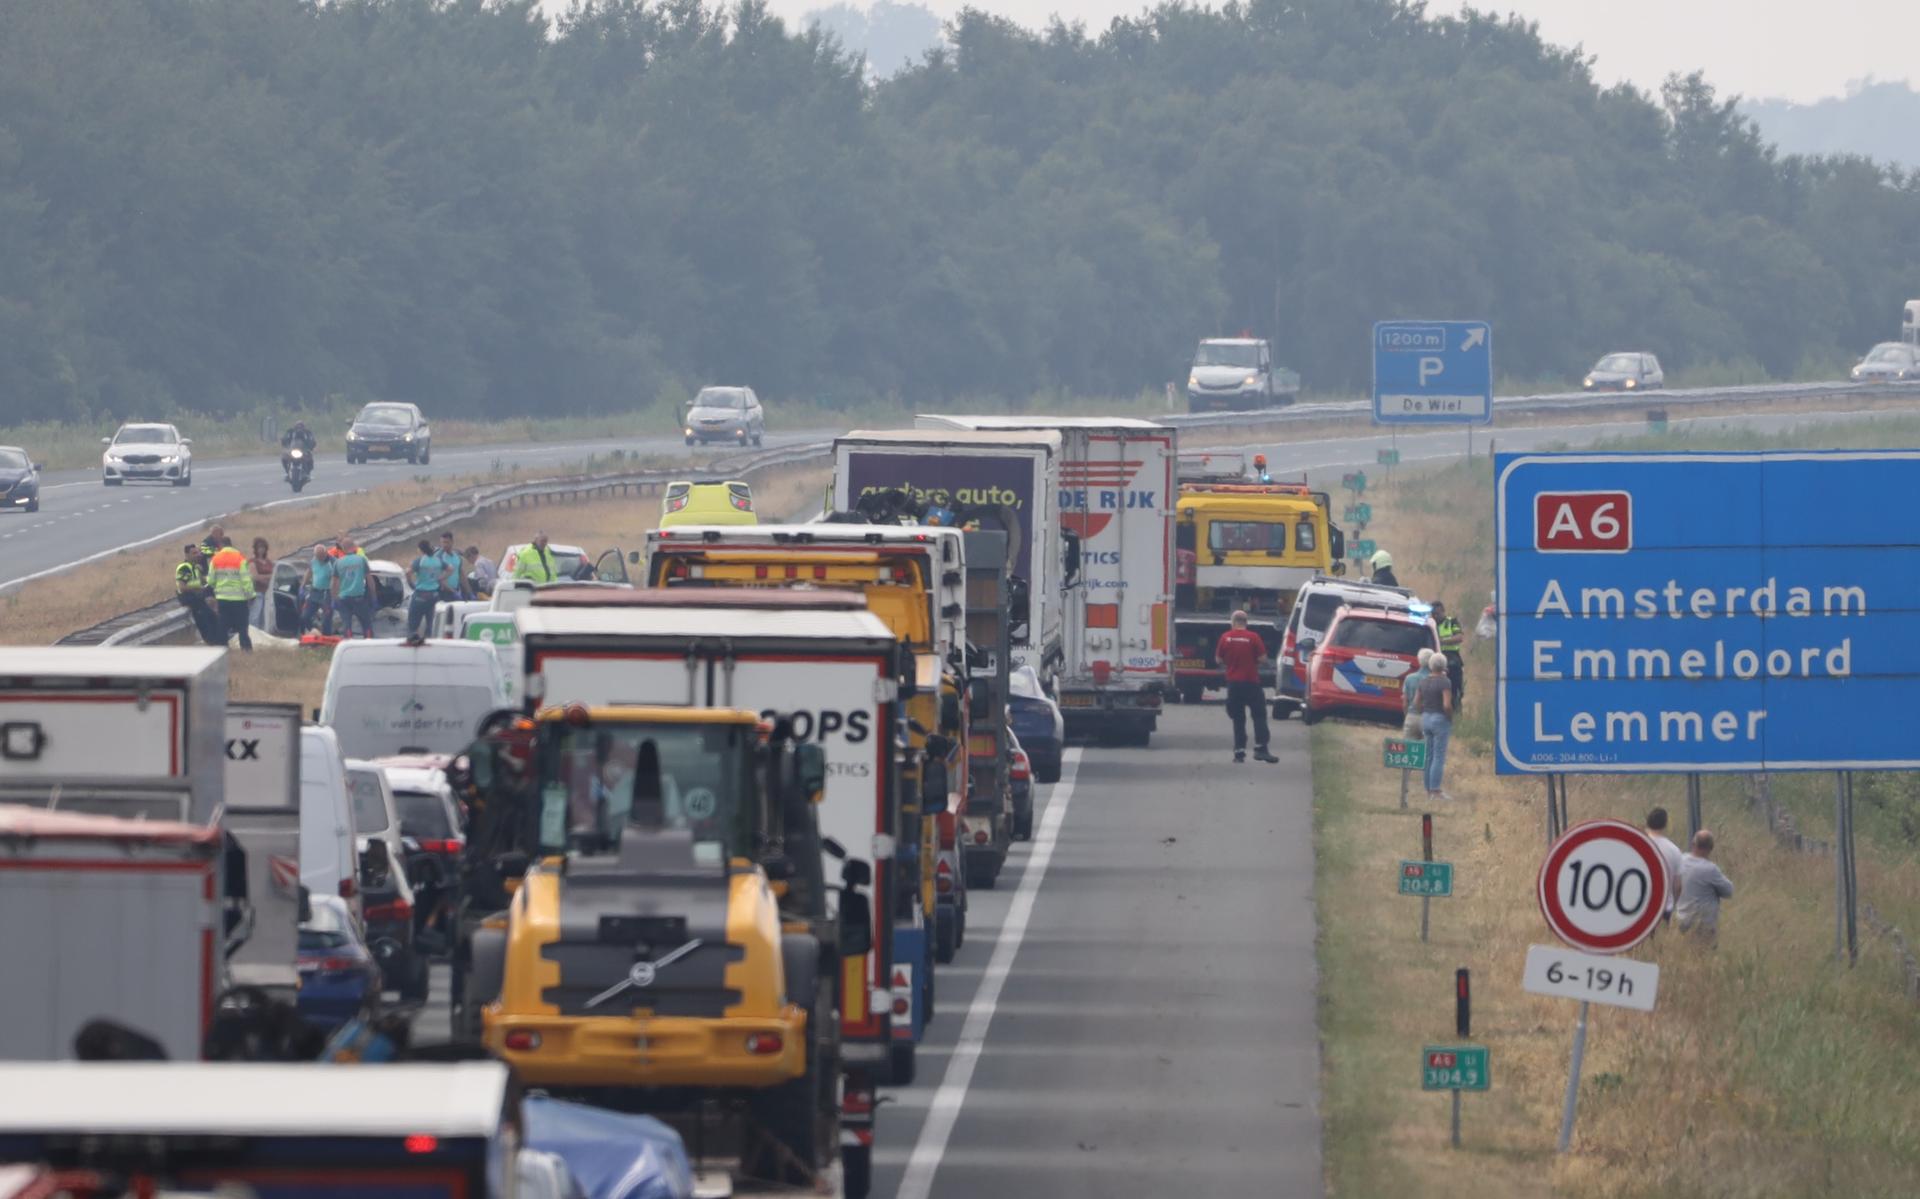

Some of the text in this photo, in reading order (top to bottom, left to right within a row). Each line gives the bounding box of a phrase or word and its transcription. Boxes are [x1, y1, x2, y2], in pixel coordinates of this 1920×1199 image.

[1384, 333, 1440, 345] 1200 m
[1418, 356, 1445, 387] P
[1402, 398, 1462, 411] De Wiel
[955, 485, 1023, 509] auto,
[1058, 490, 1155, 509] DE RIJK
[1546, 502, 1621, 540] A6
[1534, 576, 1867, 619] Amsterdam
[1533, 637, 1852, 680] Emmeloord
[1534, 701, 1769, 743] Lemmer
[1569, 859, 1648, 916] 100
